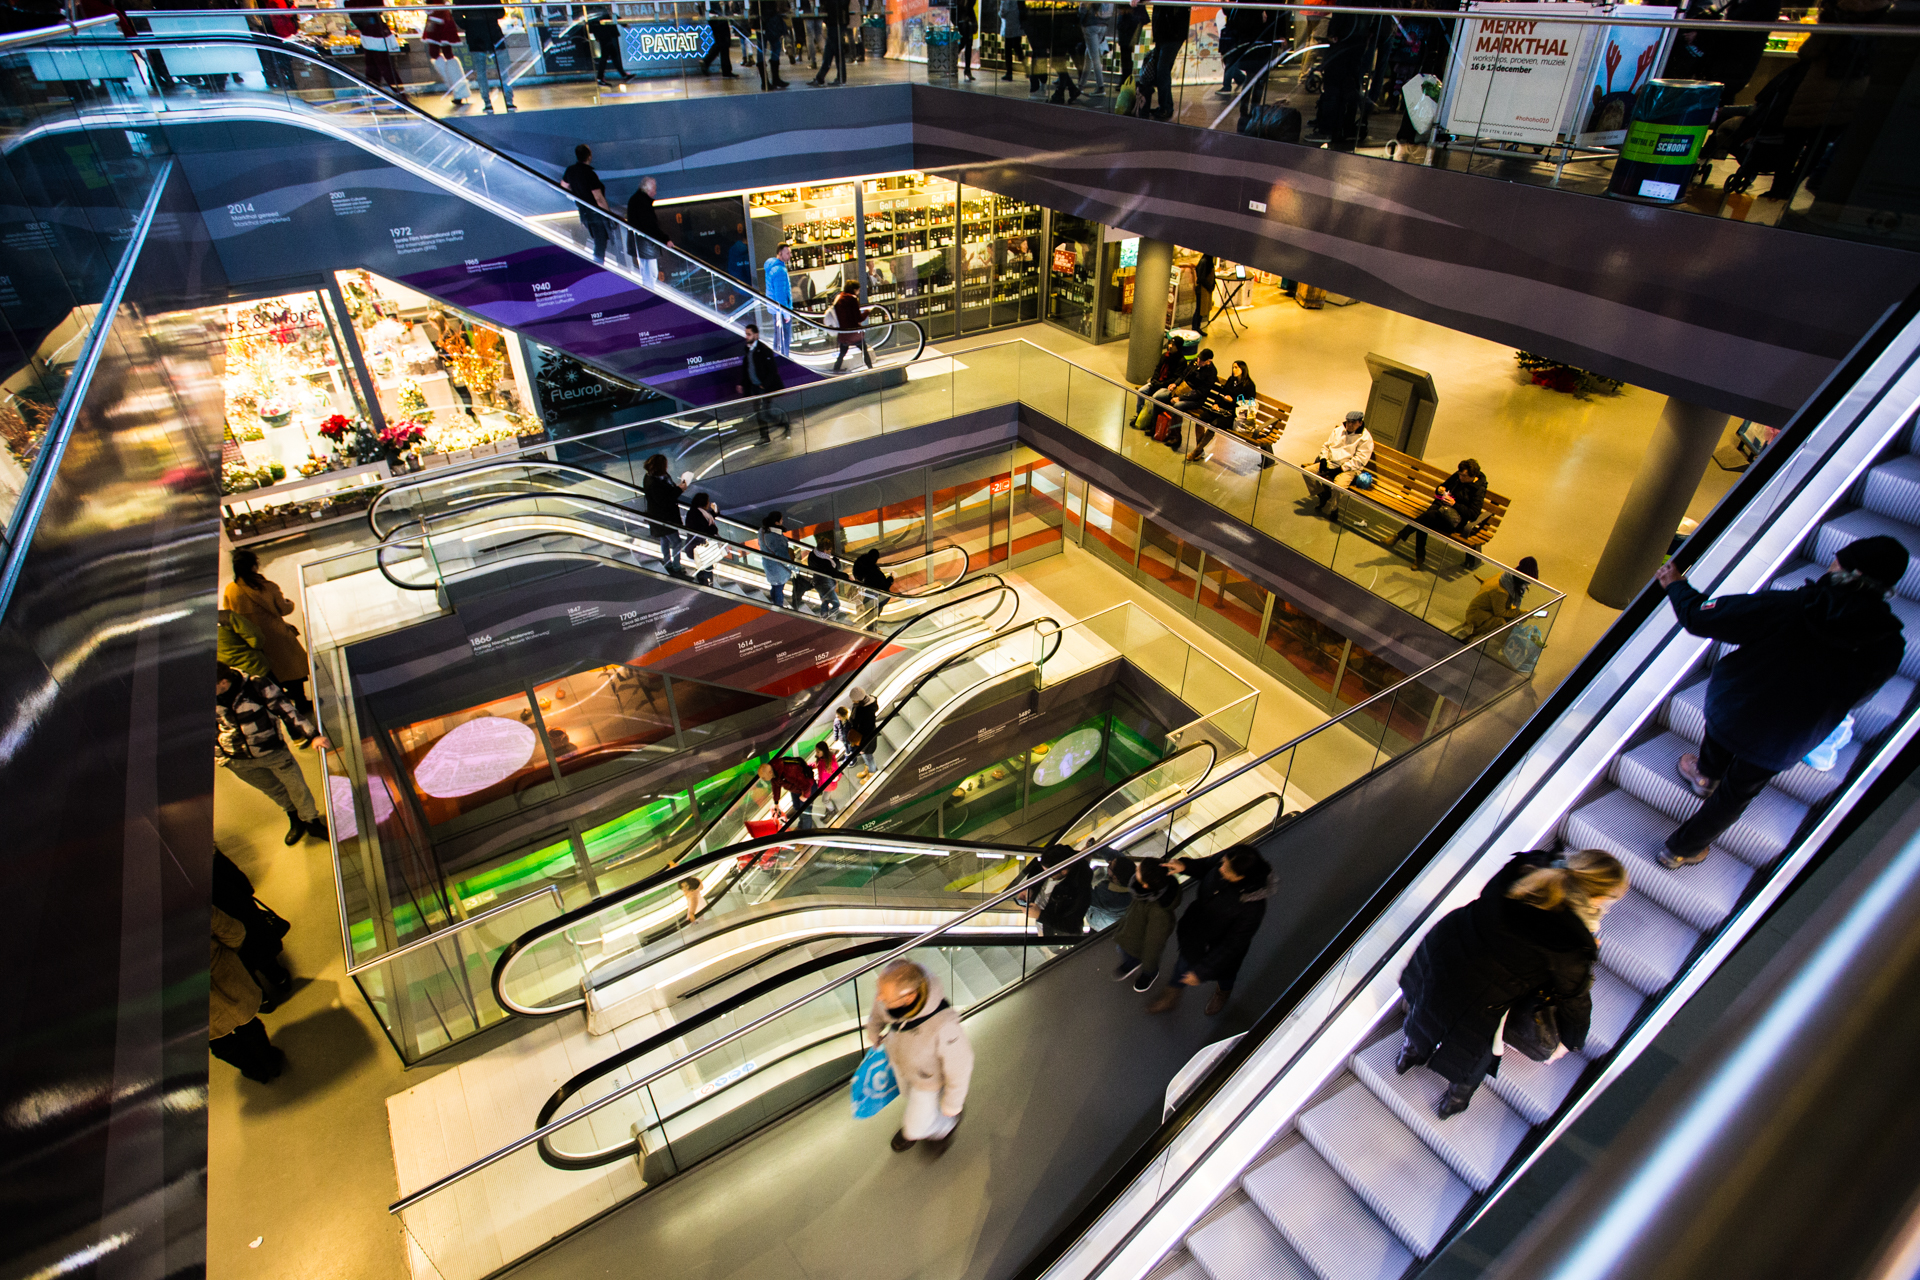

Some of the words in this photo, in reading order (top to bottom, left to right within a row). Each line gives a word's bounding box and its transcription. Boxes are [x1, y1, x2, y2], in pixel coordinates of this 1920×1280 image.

[1480, 19, 1538, 35] MERRY
[641, 32, 699, 53] PATAT
[1475, 36, 1569, 56] MARKTHAL
[1540, 58, 1566, 66] muziek
[1496, 65, 1532, 74] december
[1656, 142, 1686, 152] SCHOON
[329, 191, 345, 199] 2001
[227, 203, 255, 214] 2014
[879, 200, 893, 210] Gall
[895, 198, 909, 208] Gall
[806, 210, 820, 220] Gall
[823, 208, 837, 218] Gall
[259, 216, 291, 225] completed
[389, 226, 412, 237] 1972
[531, 282, 551, 292] 1940
[253, 313, 266, 329] &
[273, 309, 316, 325] More
[686, 356, 702, 365] 1900
[551, 384, 602, 402] Fleurop
[992, 483, 1000, 492] -2
[567, 605, 581, 614] 1847
[619, 611, 637, 621] 1700
[470, 634, 492, 646] 1866
[510, 630, 534, 640] Waterweg
[737, 639, 753, 649] 1614
[815, 651, 830, 661] 1557
[918, 764, 932, 773] 1400
[466, 897, 478, 906] -3
